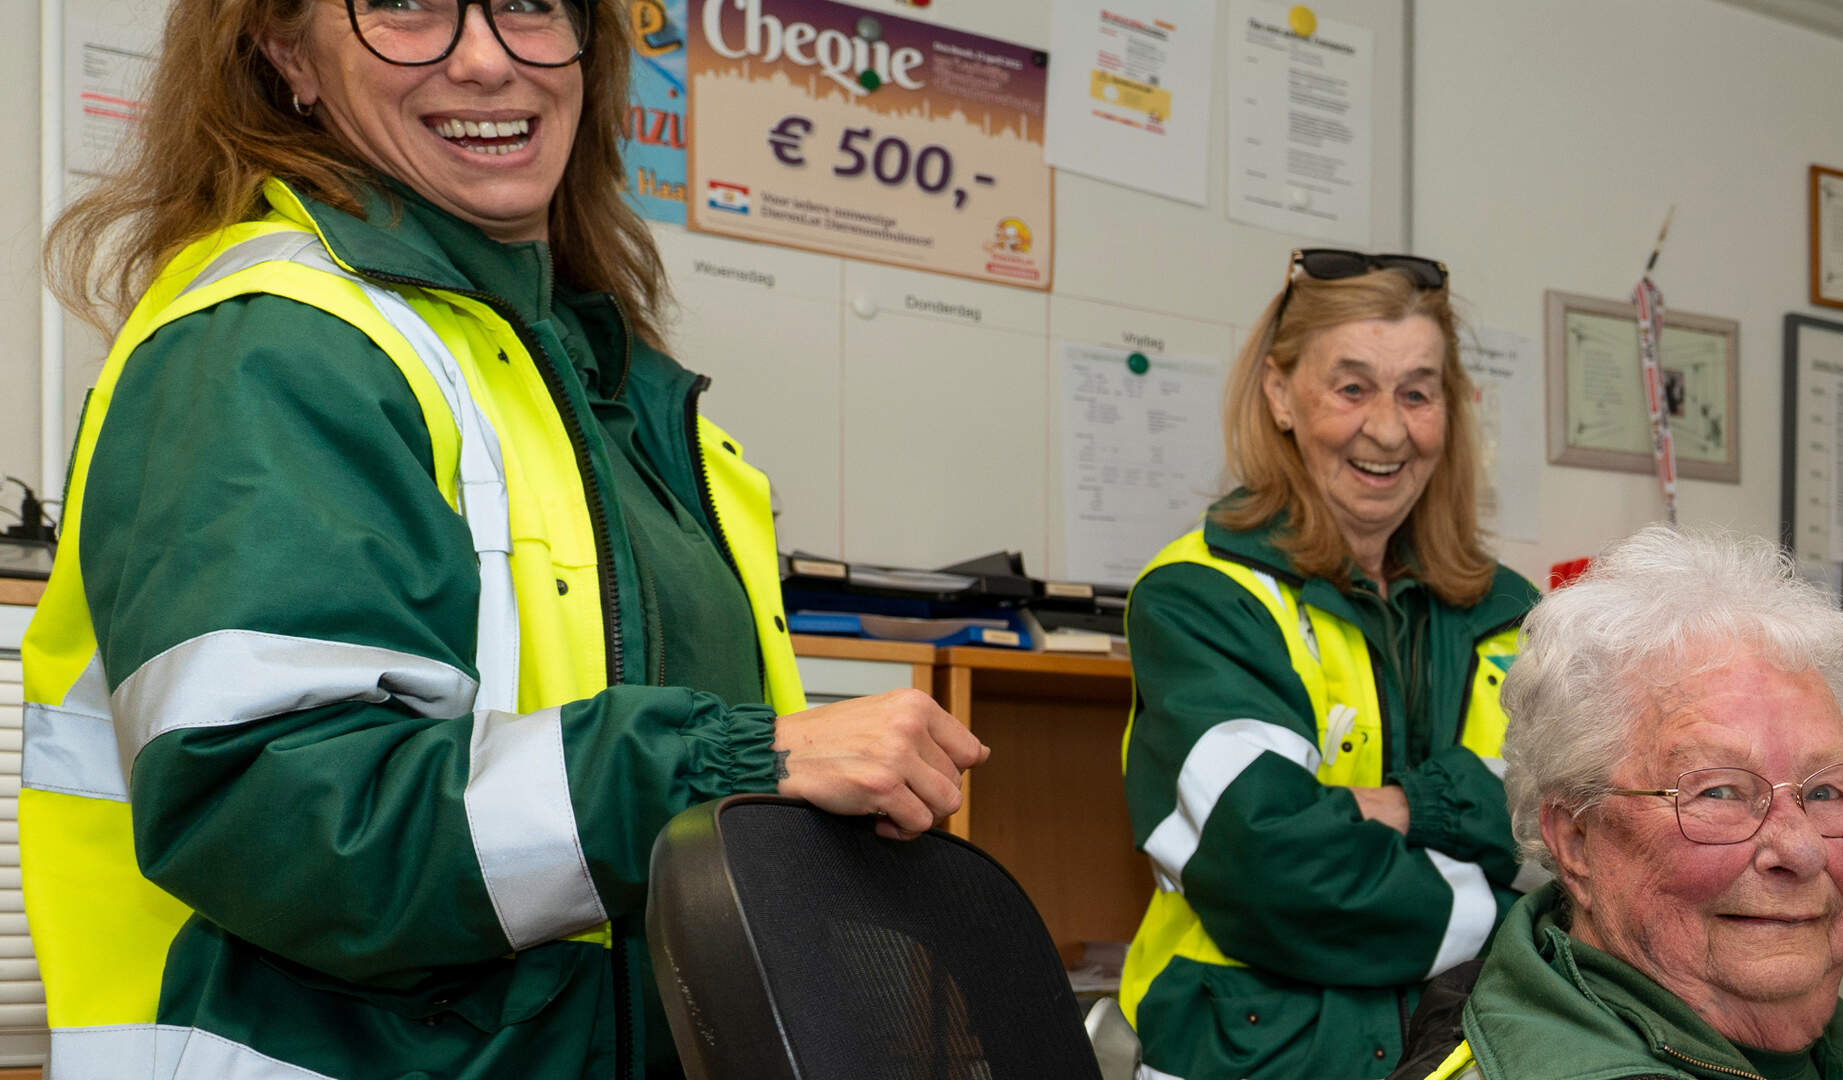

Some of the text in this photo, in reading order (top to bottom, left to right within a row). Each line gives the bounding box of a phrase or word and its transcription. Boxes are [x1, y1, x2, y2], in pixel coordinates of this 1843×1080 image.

[702, 0, 926, 96] Cheque
[768, 115, 997, 210] € 500,-
[693, 258, 776, 289] Woensdag
[905, 294, 982, 323] Donderdag
[1121, 329, 1165, 352] Vrijdag
